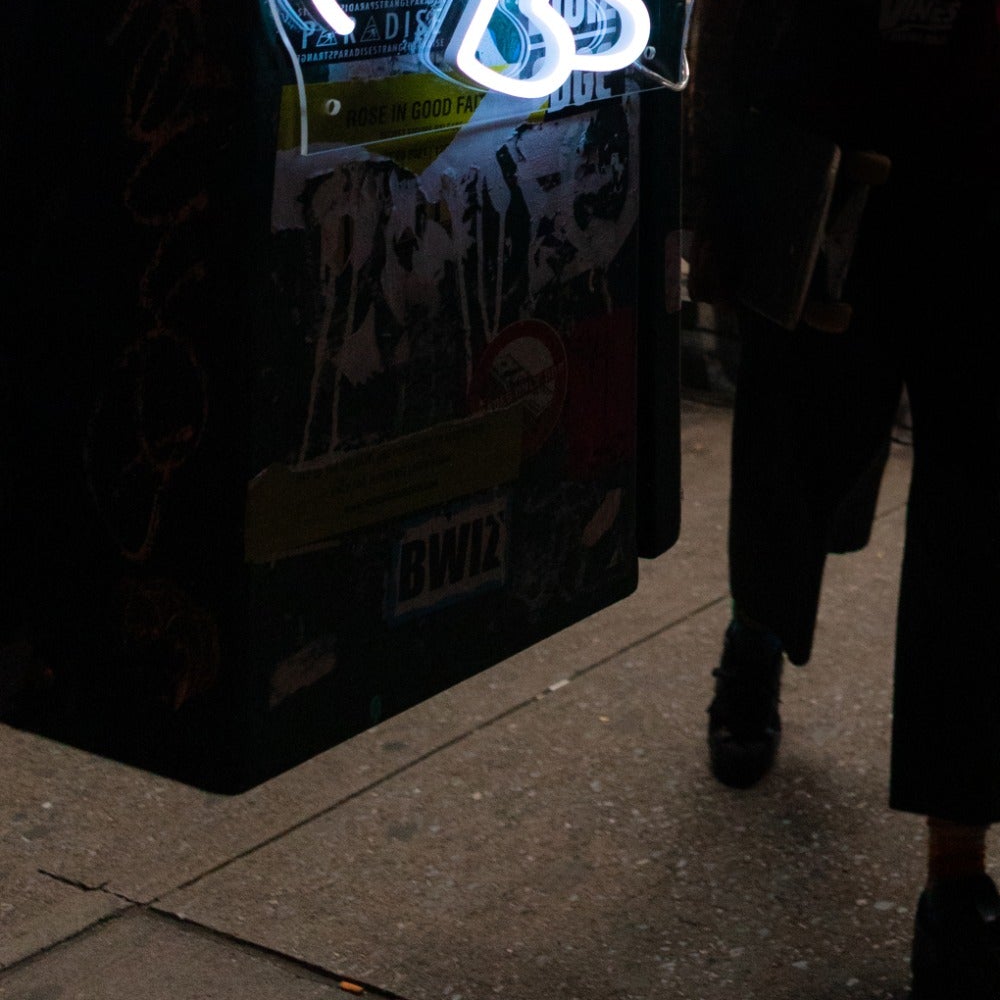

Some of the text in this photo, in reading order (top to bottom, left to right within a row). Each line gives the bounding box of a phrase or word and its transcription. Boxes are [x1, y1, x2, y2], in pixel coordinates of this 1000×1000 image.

[346, 104, 387, 129] ROSE
[392, 102, 407, 123] IN
[411, 97, 452, 120] GOOD
